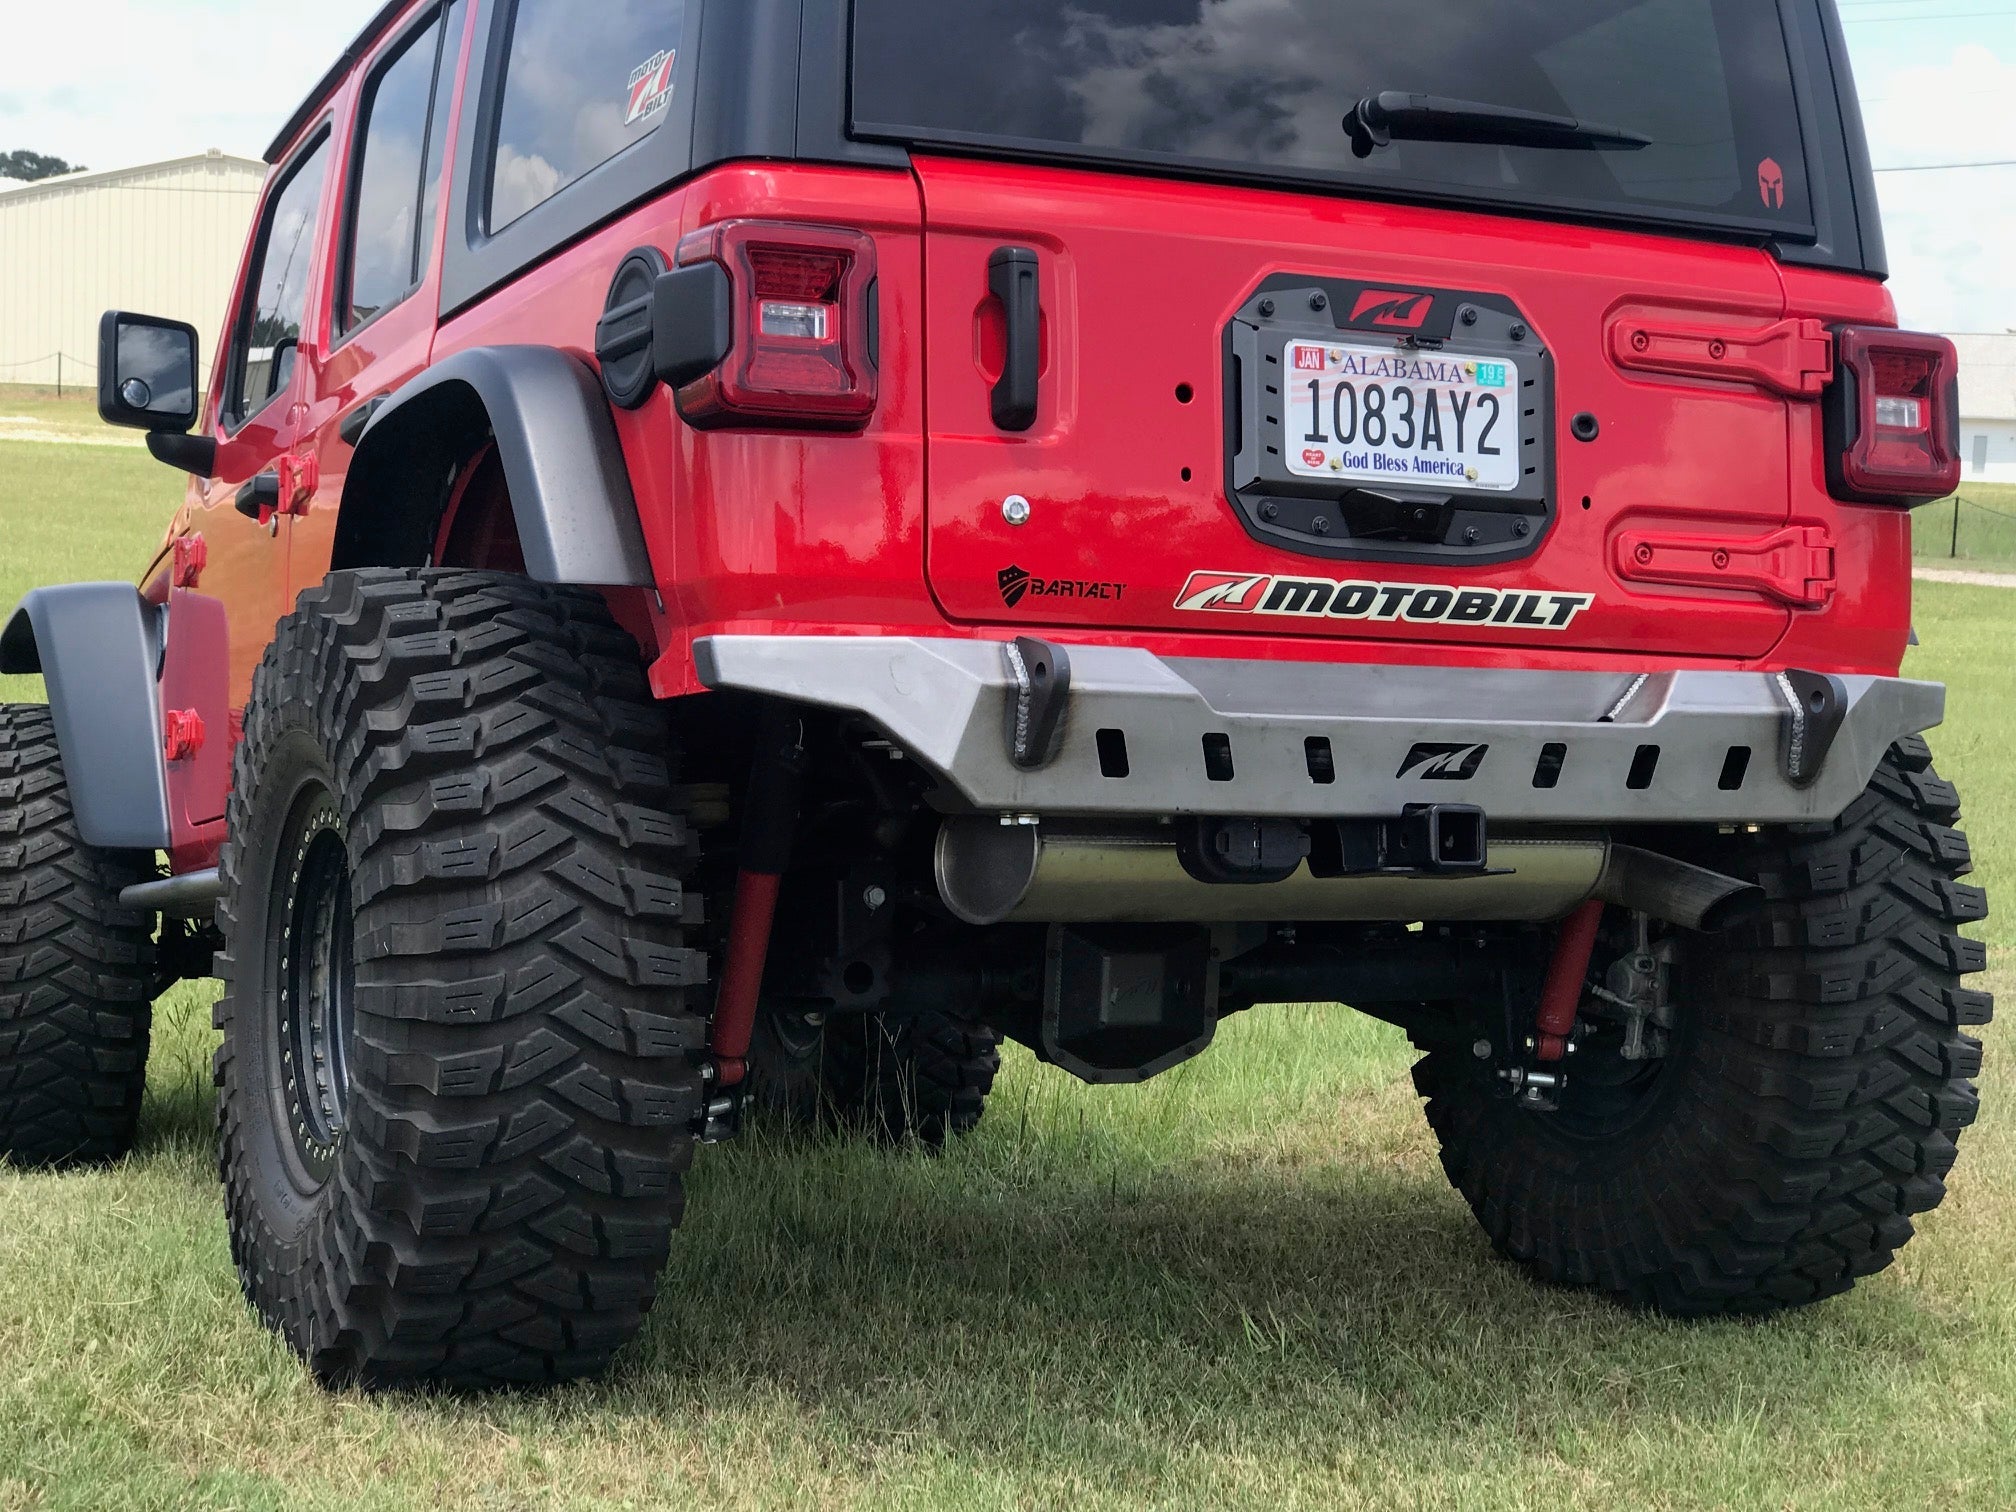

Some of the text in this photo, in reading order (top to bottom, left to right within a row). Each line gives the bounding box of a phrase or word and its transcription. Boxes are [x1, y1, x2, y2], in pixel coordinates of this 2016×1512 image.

[643, 91, 670, 117] BILT
[1298, 350, 1320, 369] JAN
[1342, 356, 1465, 383] ALABAMA
[1481, 364, 1495, 379] 19
[1304, 379, 1501, 456] 1083AY2
[1342, 450, 1465, 476] God Bless America
[1030, 578, 1128, 600] BARTACT
[1262, 580, 1587, 626] MOTOBILT
